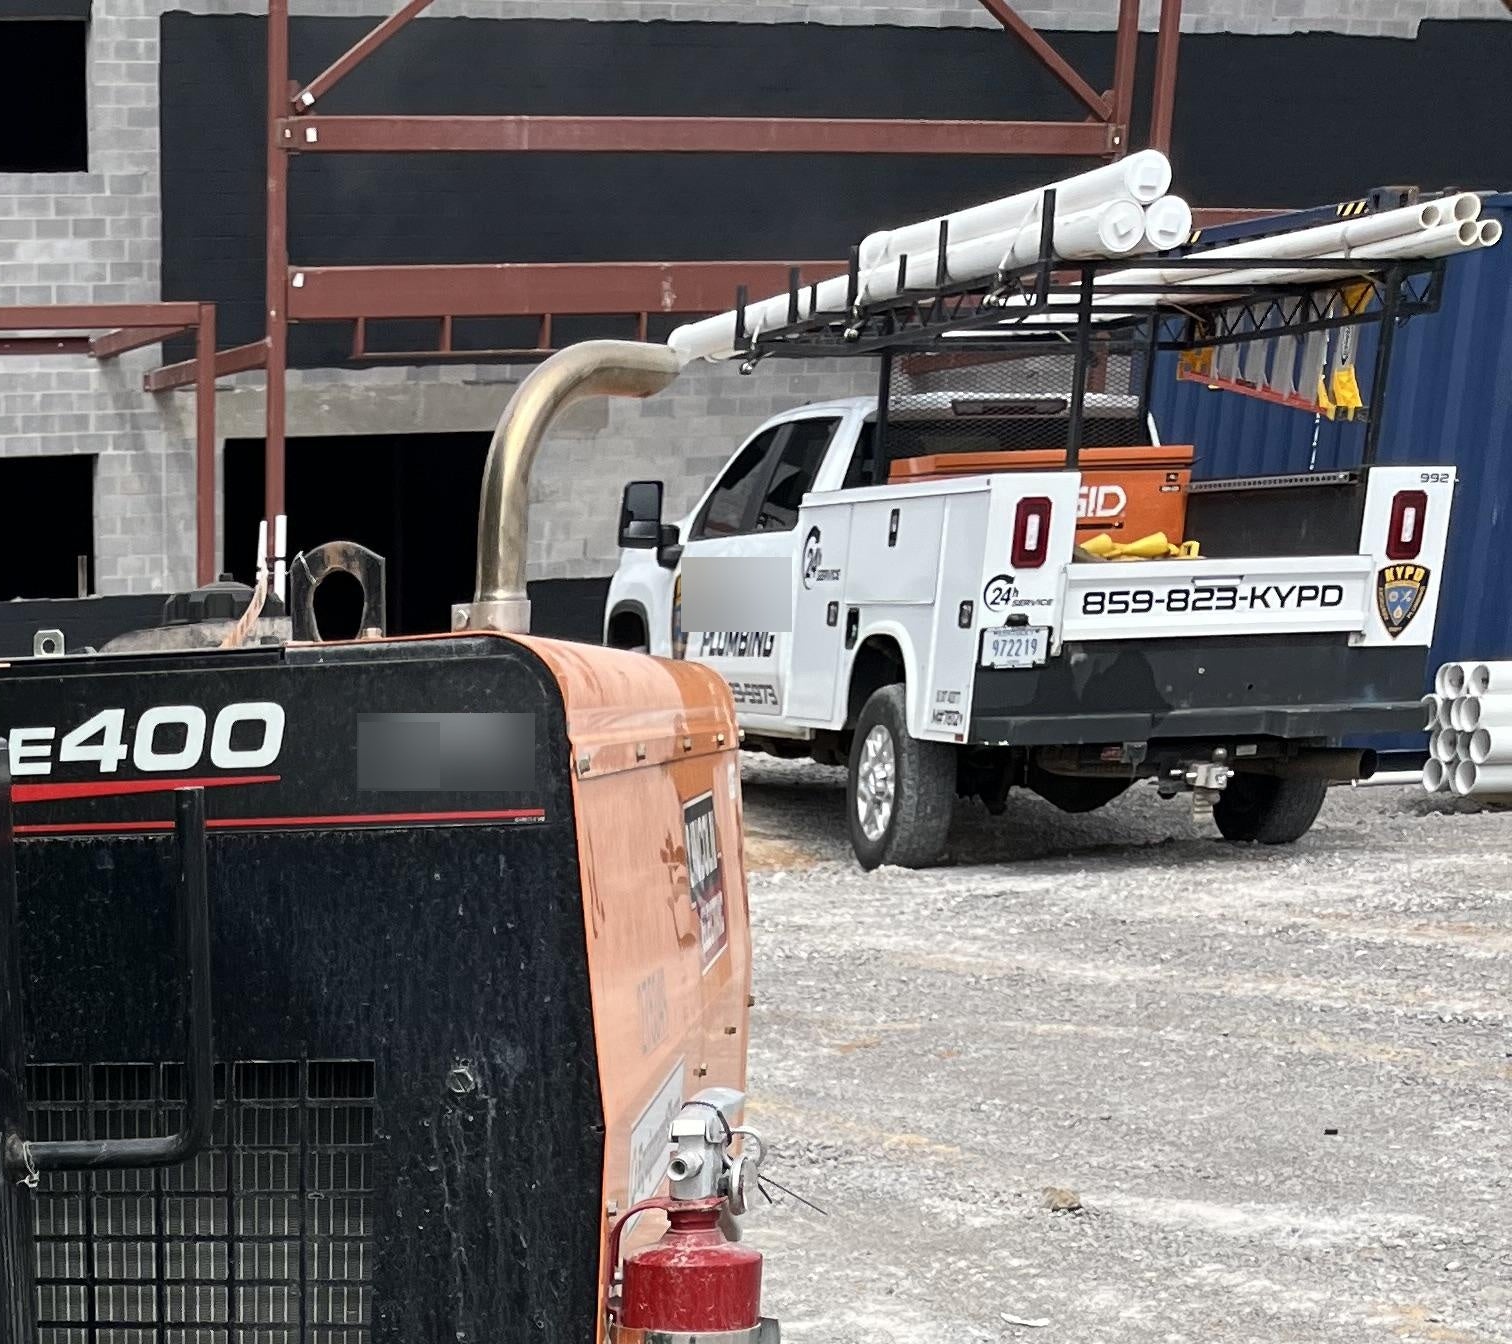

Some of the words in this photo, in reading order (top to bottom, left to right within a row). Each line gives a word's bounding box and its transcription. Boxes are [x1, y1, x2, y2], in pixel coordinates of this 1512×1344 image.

[1420, 473, 1450, 484] 992
[1384, 566, 1426, 582] KYPD
[1082, 584, 1344, 615] 859-823-KYPD
[992, 638, 1038, 657] 972219
